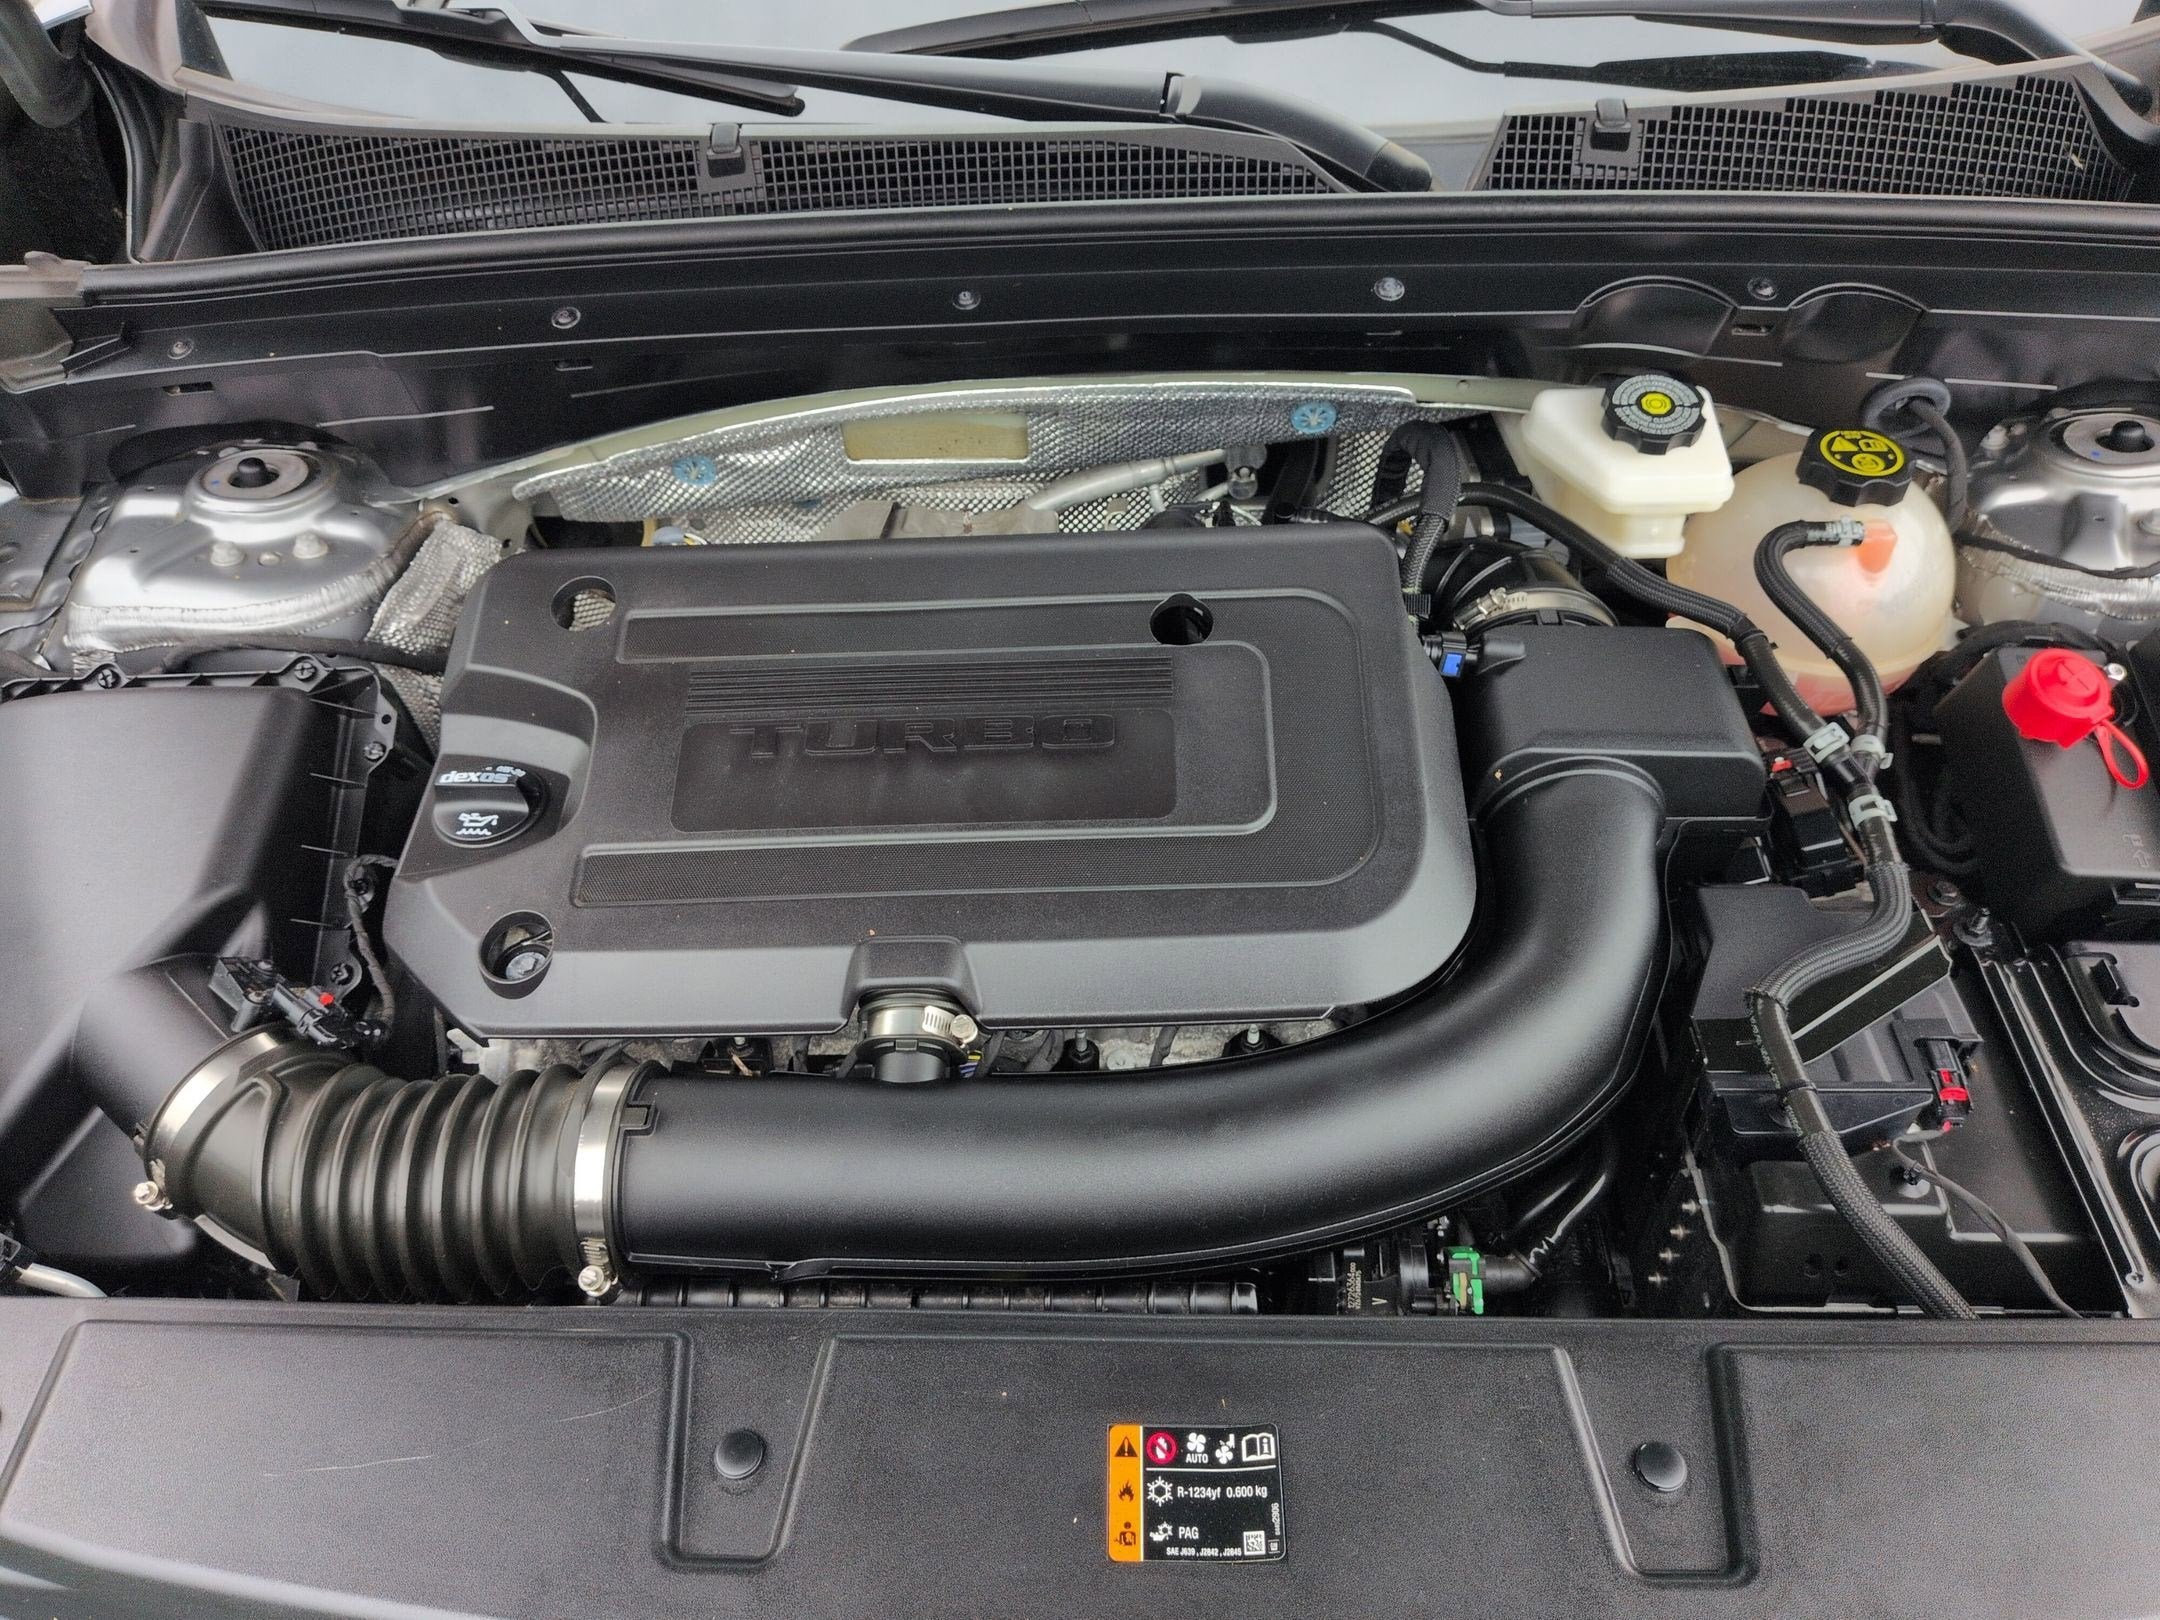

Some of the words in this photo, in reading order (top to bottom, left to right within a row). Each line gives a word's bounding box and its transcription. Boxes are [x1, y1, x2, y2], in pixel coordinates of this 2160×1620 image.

[729, 714, 1115, 758] TURBO
[439, 770, 511, 783] dexos
[1186, 1453, 1209, 1463] AUTO
[1177, 1486, 1221, 1500] R-1234yf
[1226, 1486, 1254, 1498] 0.600
[1255, 1485, 1268, 1498] kg
[1178, 1526, 1199, 1539] PAG
[1166, 1547, 1179, 1556] SAE
